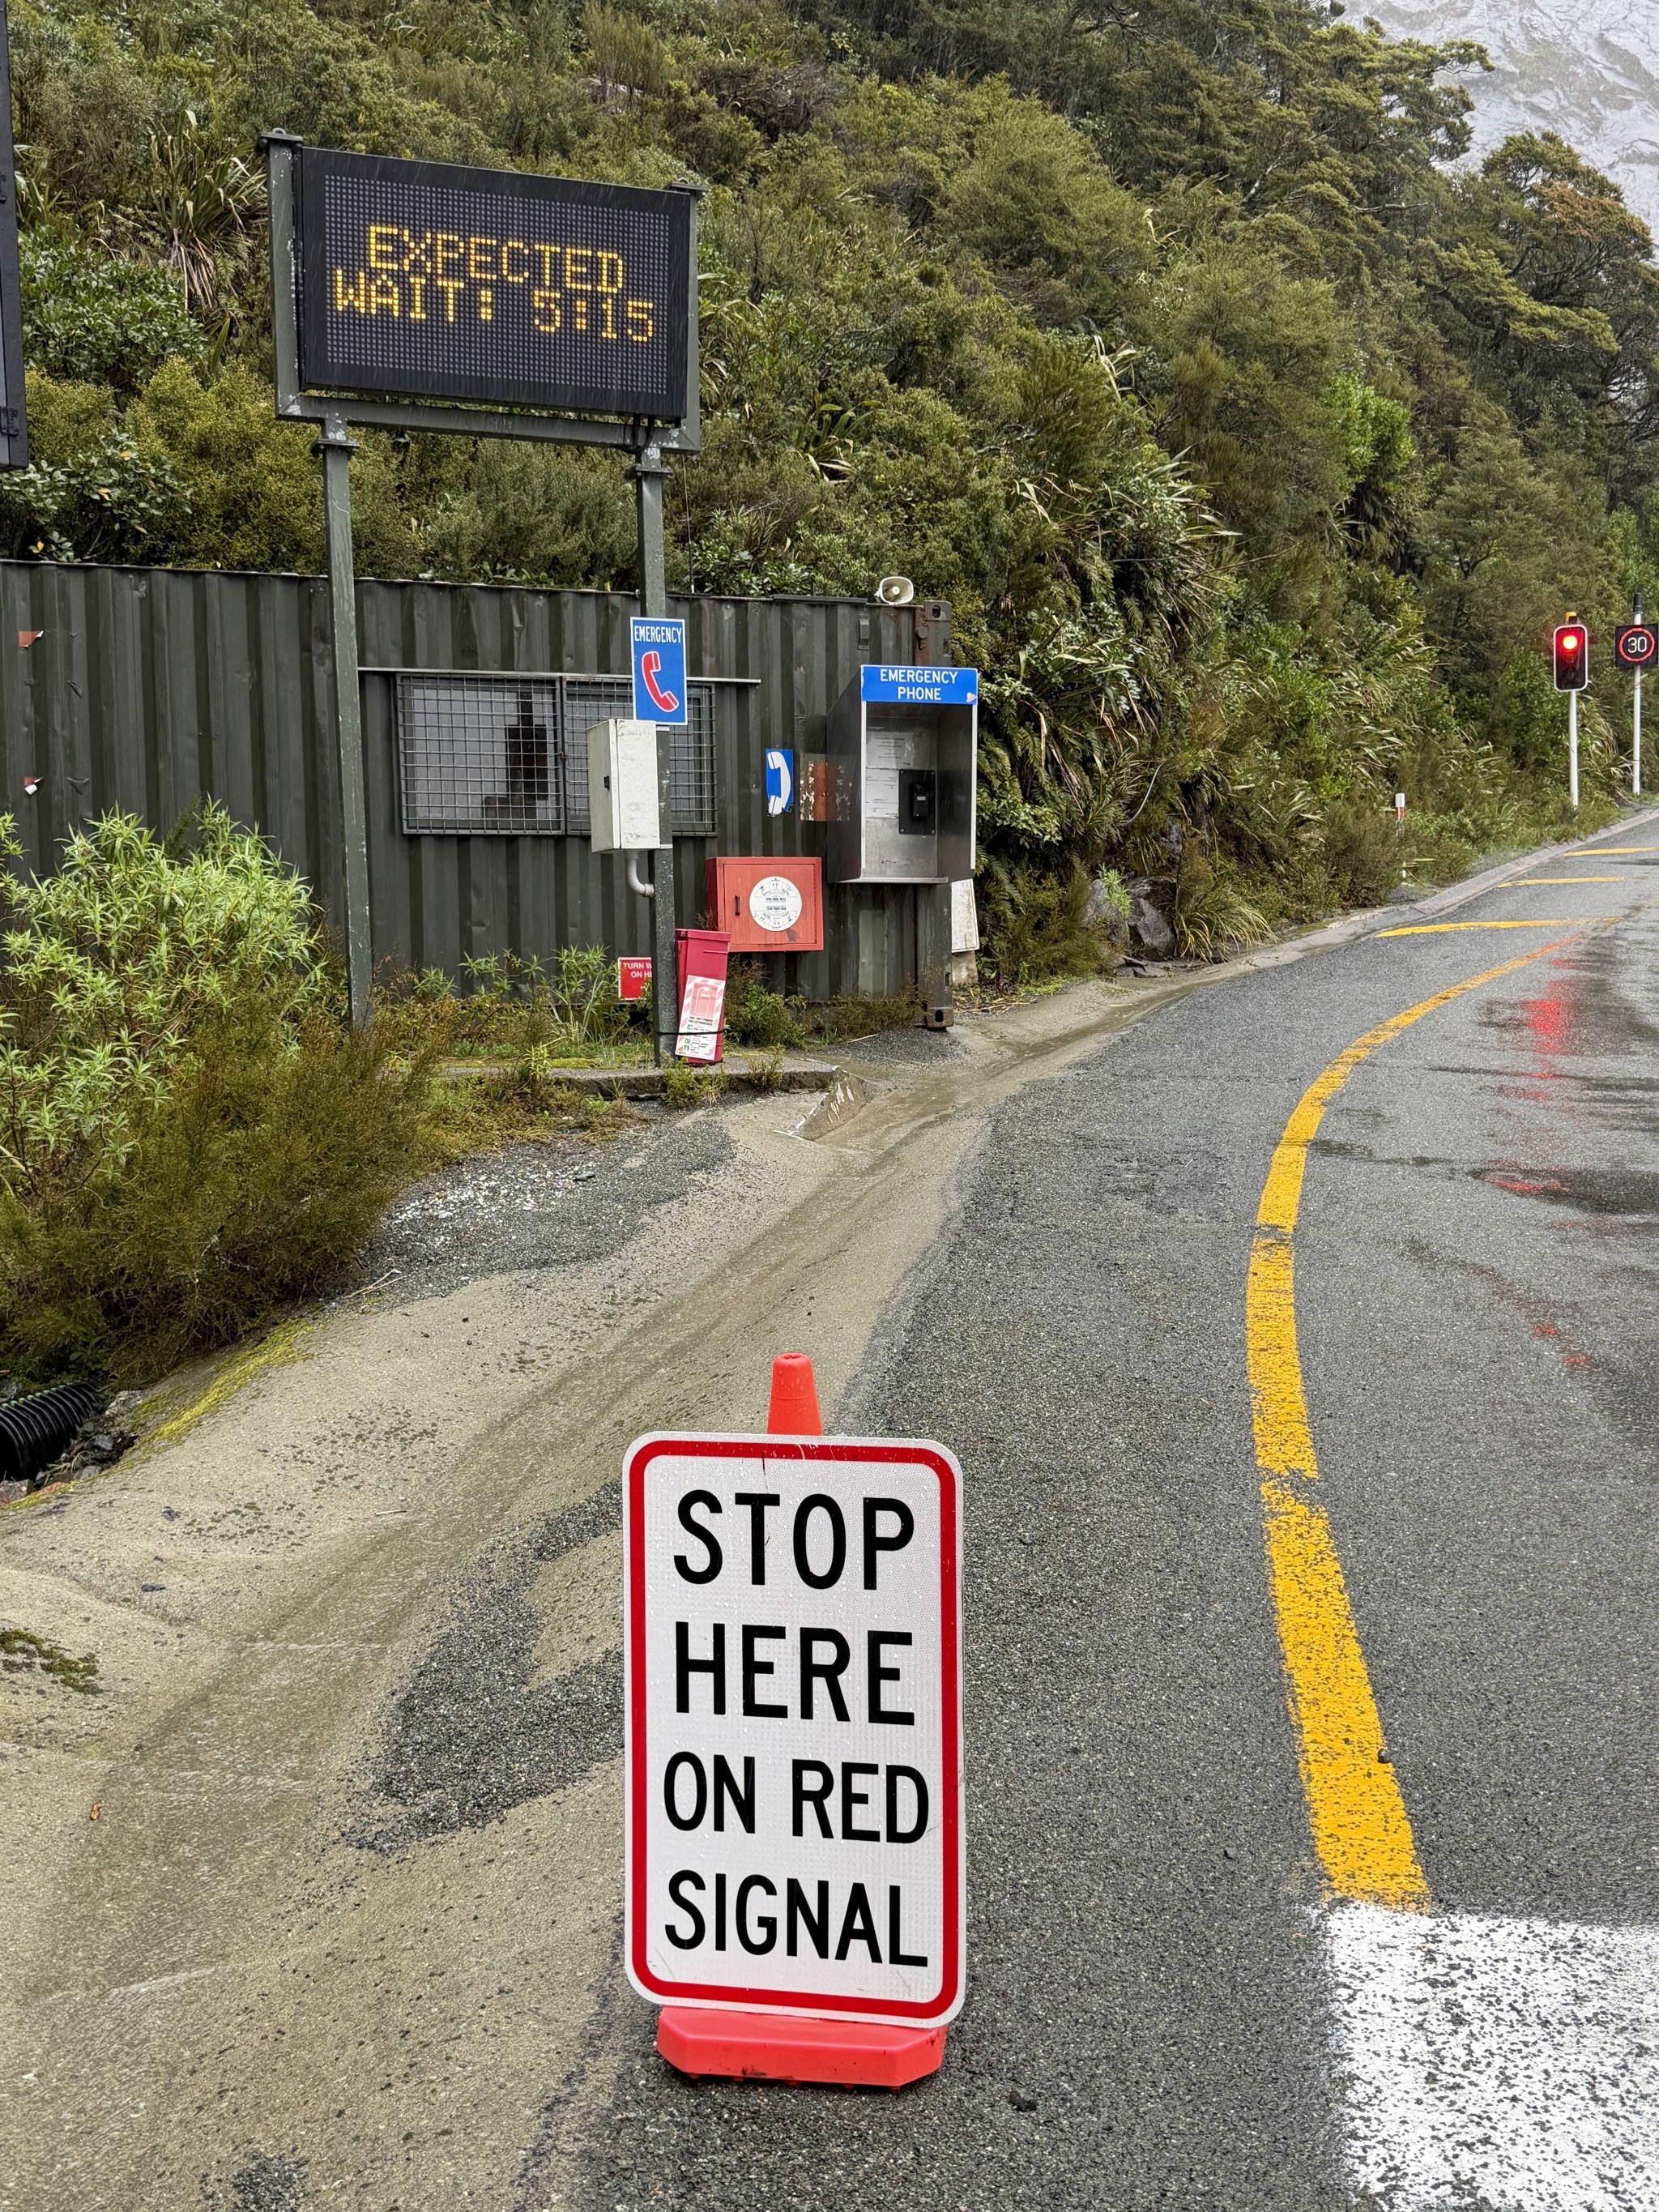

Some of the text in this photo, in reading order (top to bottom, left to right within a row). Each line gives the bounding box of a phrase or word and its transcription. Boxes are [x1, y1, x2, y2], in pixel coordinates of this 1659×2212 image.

[369, 225, 623, 294] EXPECTED
[336, 269, 653, 342] WAIT: 5:15
[634, 626, 682, 643] EMERGENCY
[1627, 636, 1647, 653] 30
[881, 668, 958, 684] EMERGENCY
[898, 686, 942, 700] PHONE
[673, 1489, 915, 1591] STOP
[675, 1621, 915, 1726] HERE
[663, 1751, 929, 1844] ON RED
[663, 1869, 928, 1967] SIGNAL
